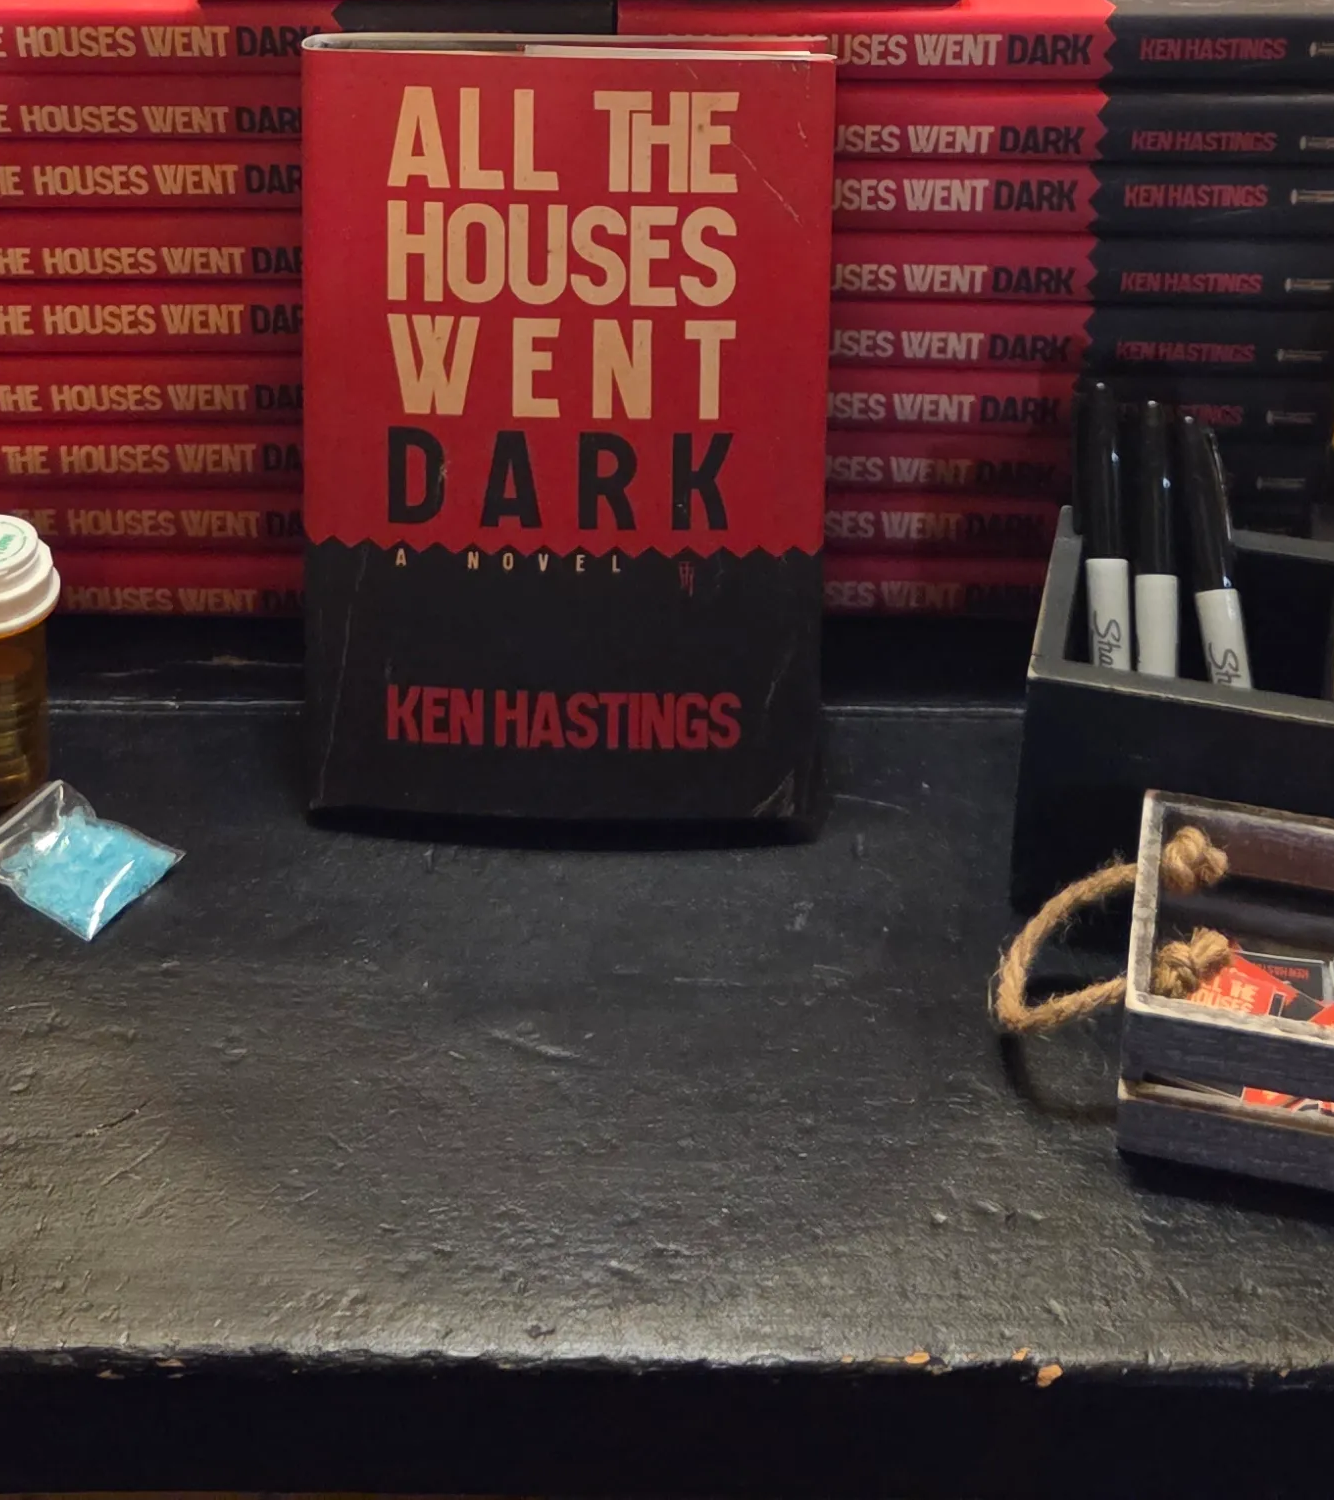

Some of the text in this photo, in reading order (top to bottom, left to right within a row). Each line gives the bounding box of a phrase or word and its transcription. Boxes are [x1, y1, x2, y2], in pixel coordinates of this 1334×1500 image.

[386, 84, 741, 194] ALL THE
[386, 199, 739, 308] HOUSES
[386, 312, 737, 421] WENT
[387, 425, 734, 532] DARK
[395, 547, 622, 575] A NOVEL
[386, 684, 742, 751] KEN HASTINGS
